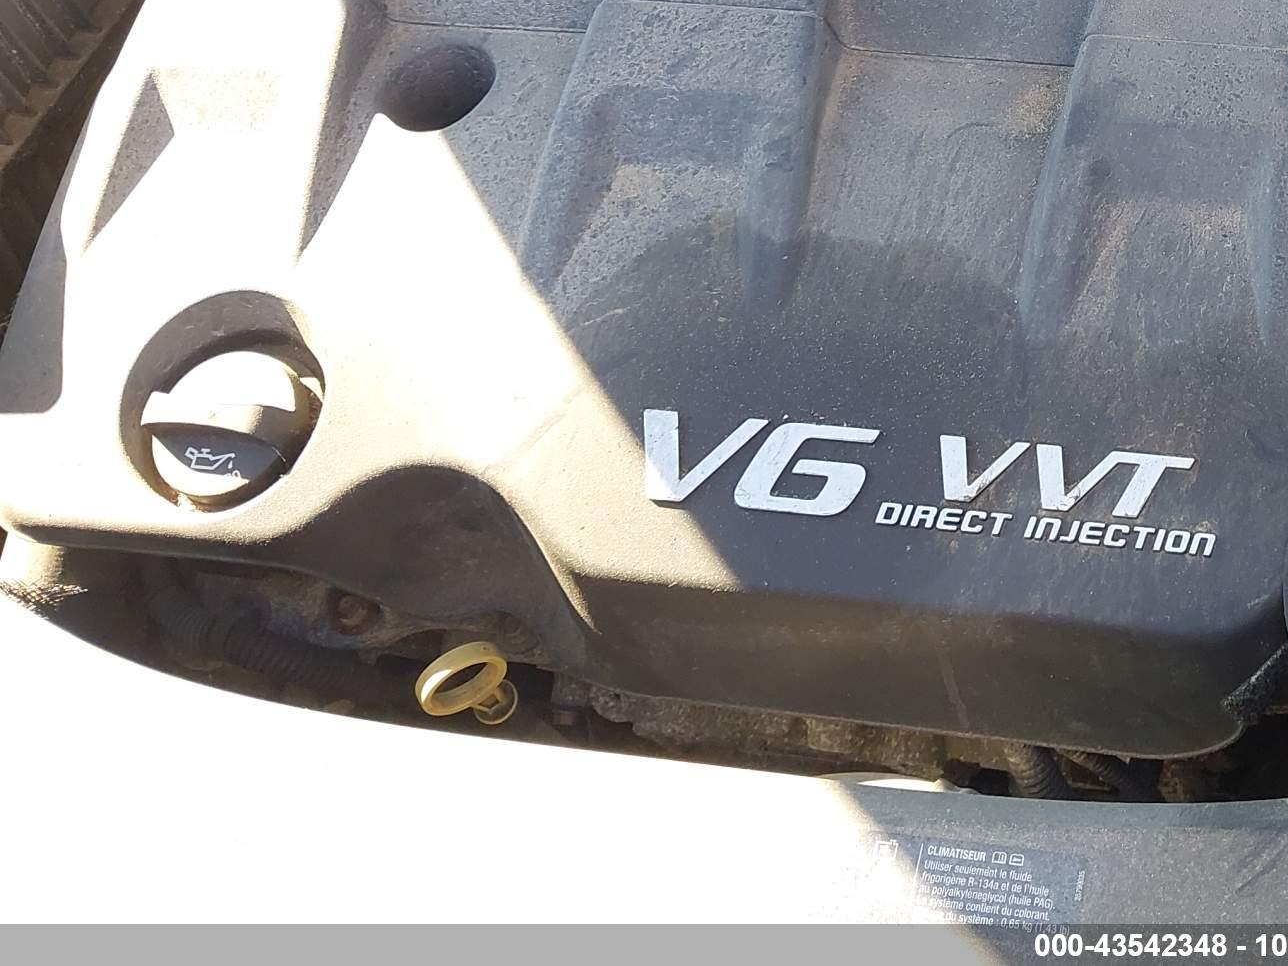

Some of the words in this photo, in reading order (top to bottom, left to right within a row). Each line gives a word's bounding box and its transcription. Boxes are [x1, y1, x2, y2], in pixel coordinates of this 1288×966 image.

[642, 407, 882, 517] V6
[938, 434, 1195, 518] VVT
[874, 501, 1012, 537] DIRECT
[1023, 516, 1218, 558] INJECTION
[926, 845, 987, 862] CLIMATISEUR
[924, 860, 953, 872] Utiliser
[954, 864, 997, 878] seulement
[999, 869, 1007, 879] le
[1009, 869, 1032, 882] fluide
[967, 877, 999, 891] R-134a
[1000, 881, 1009, 891] et
[1011, 883, 1022, 893] de
[965, 901, 999, 915] contient
[1001, 906, 1013, 916] du
[1008, 894, 1031, 906] (huile
[1033, 896, 1056, 910] PAG).
[1001, 918, 1020, 930] 0,65
[1021, 920, 1033, 933] kg
